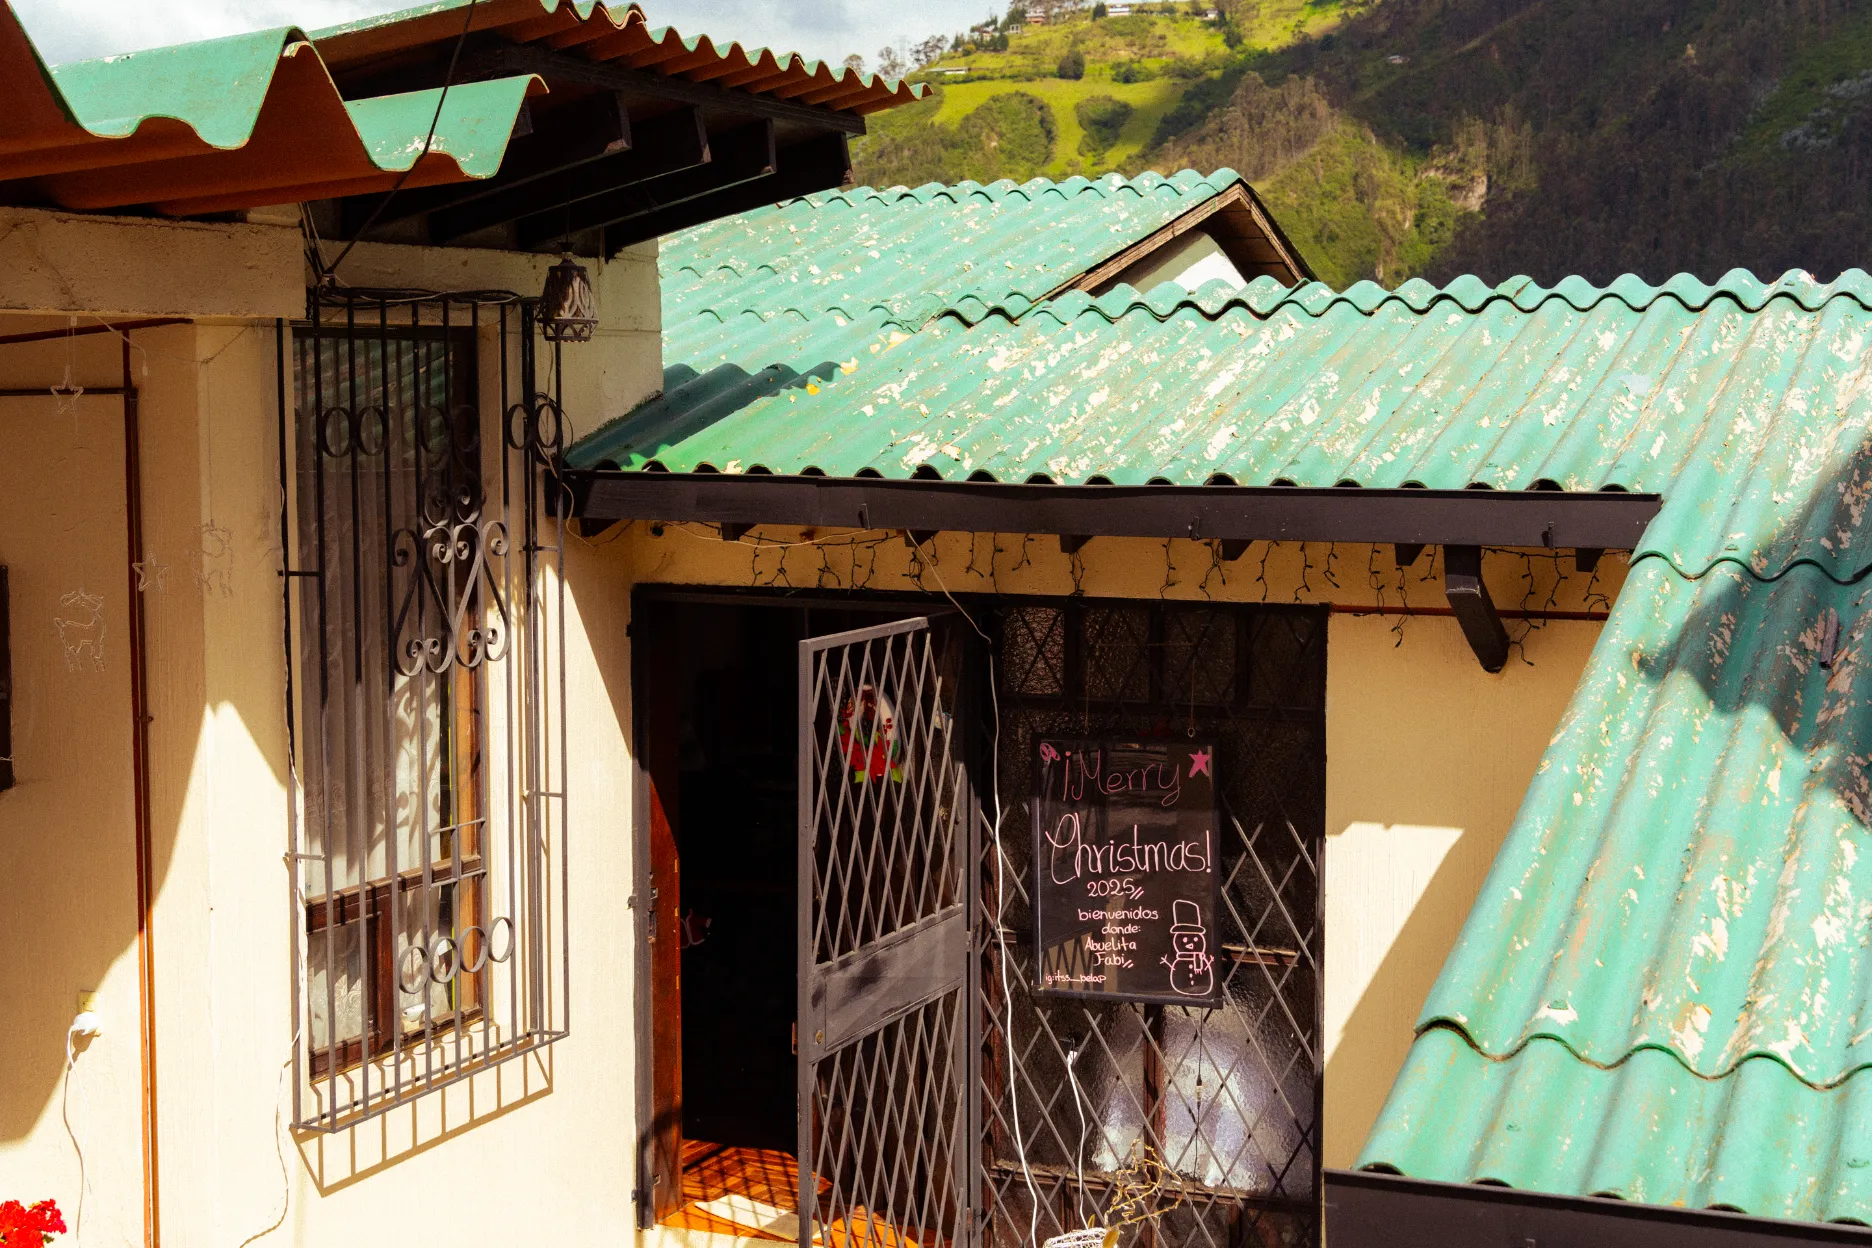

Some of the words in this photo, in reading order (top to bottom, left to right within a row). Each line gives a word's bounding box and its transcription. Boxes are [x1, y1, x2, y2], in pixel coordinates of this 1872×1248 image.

[1045, 812, 1211, 884] Christmas!
[1077, 906, 1159, 920] bienvenidos
[1101, 922, 1141, 934] donde:
[1085, 937, 1136, 951] Abuelita
